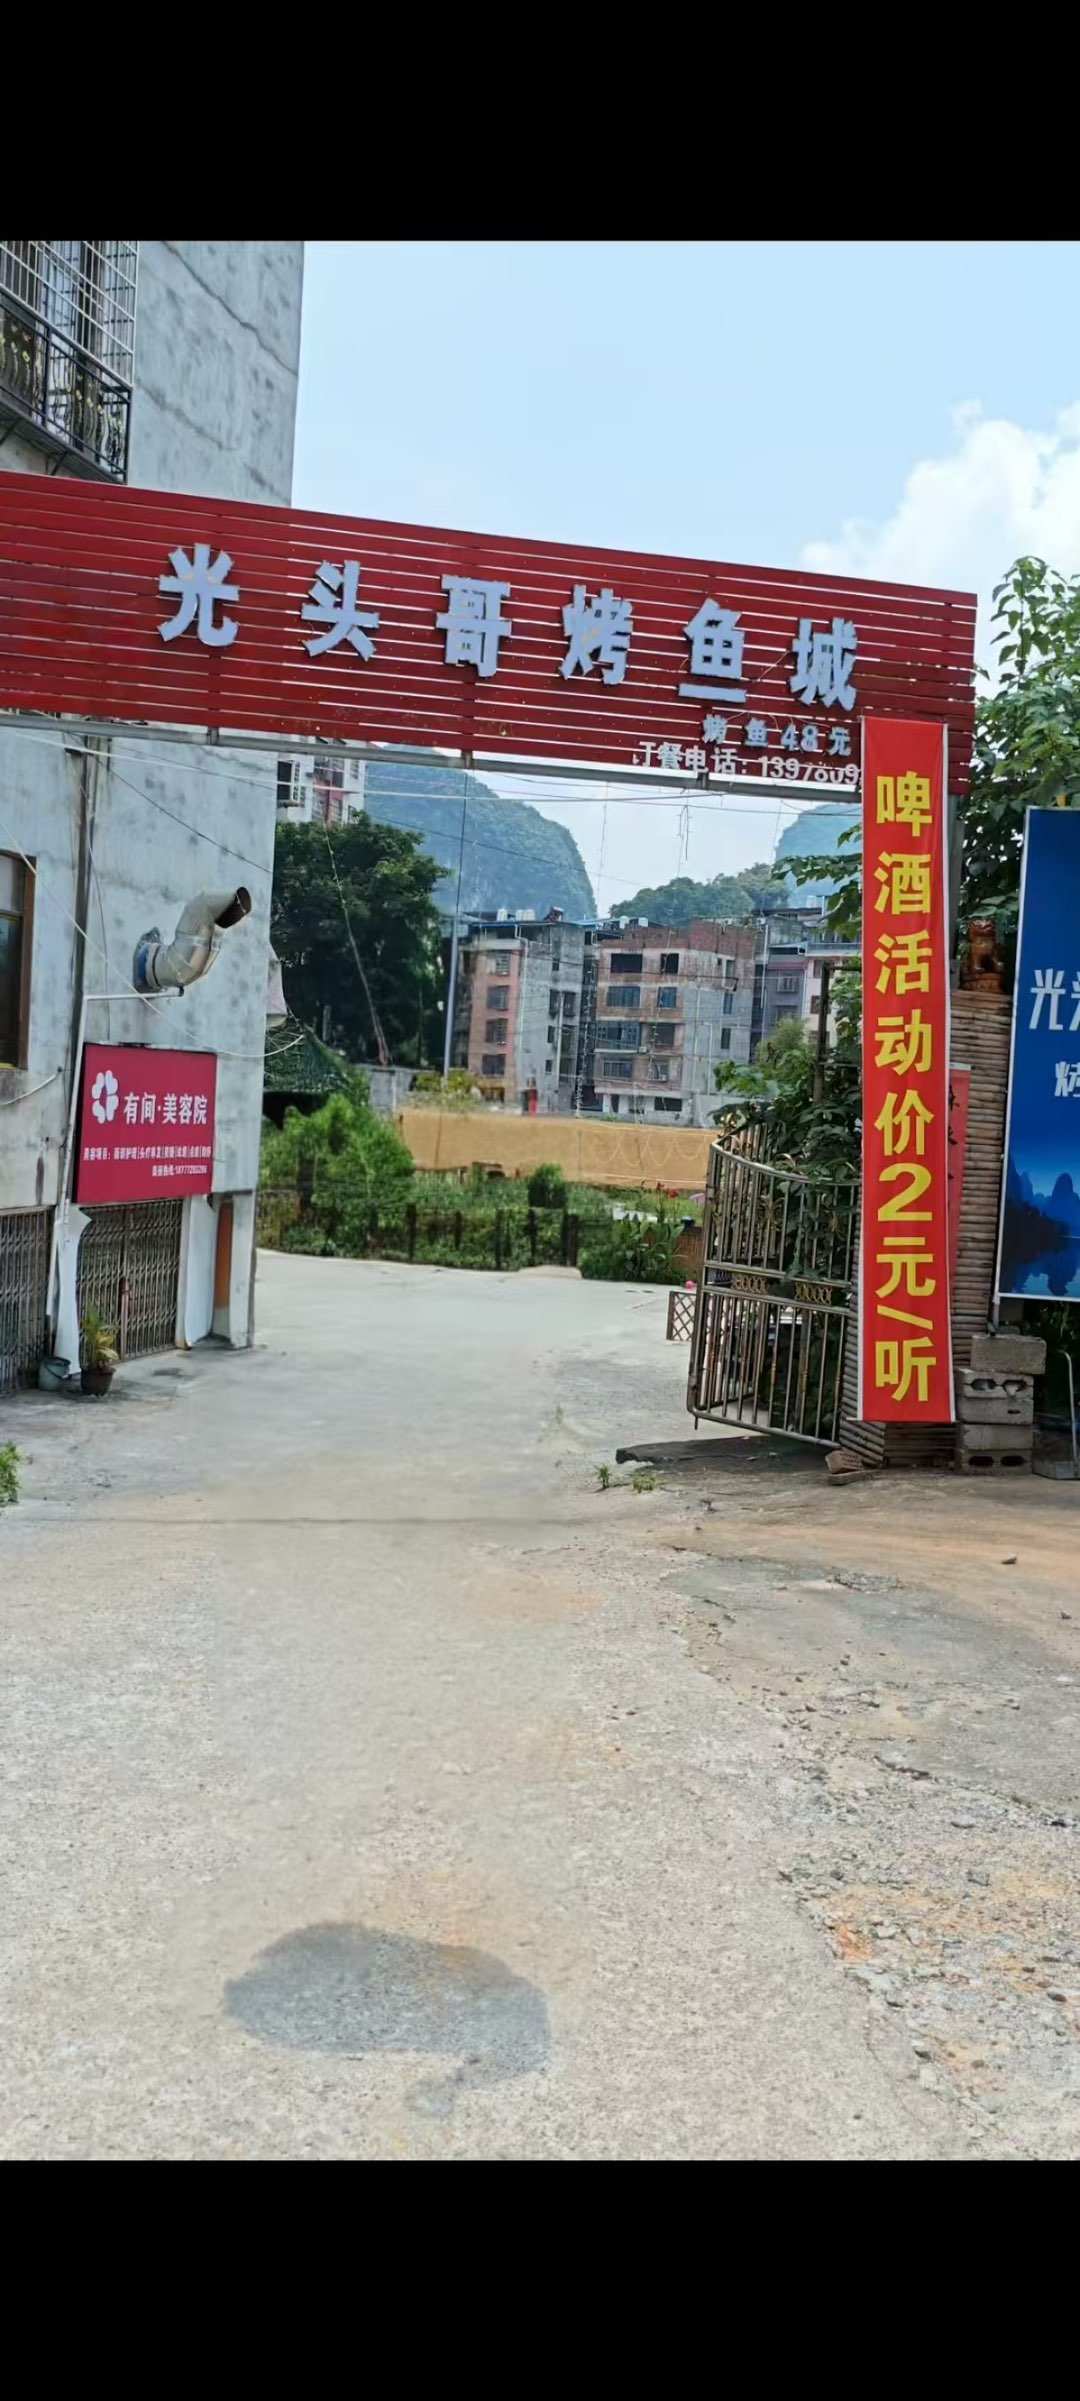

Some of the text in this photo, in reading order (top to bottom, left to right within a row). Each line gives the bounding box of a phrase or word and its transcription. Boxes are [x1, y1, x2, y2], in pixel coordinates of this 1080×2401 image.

[157, 543, 858, 711] 光头哥烤鱼城
[1029, 968, 1080, 1031] 光
[873, 770, 936, 1402] 啤酒活动价2元/听
